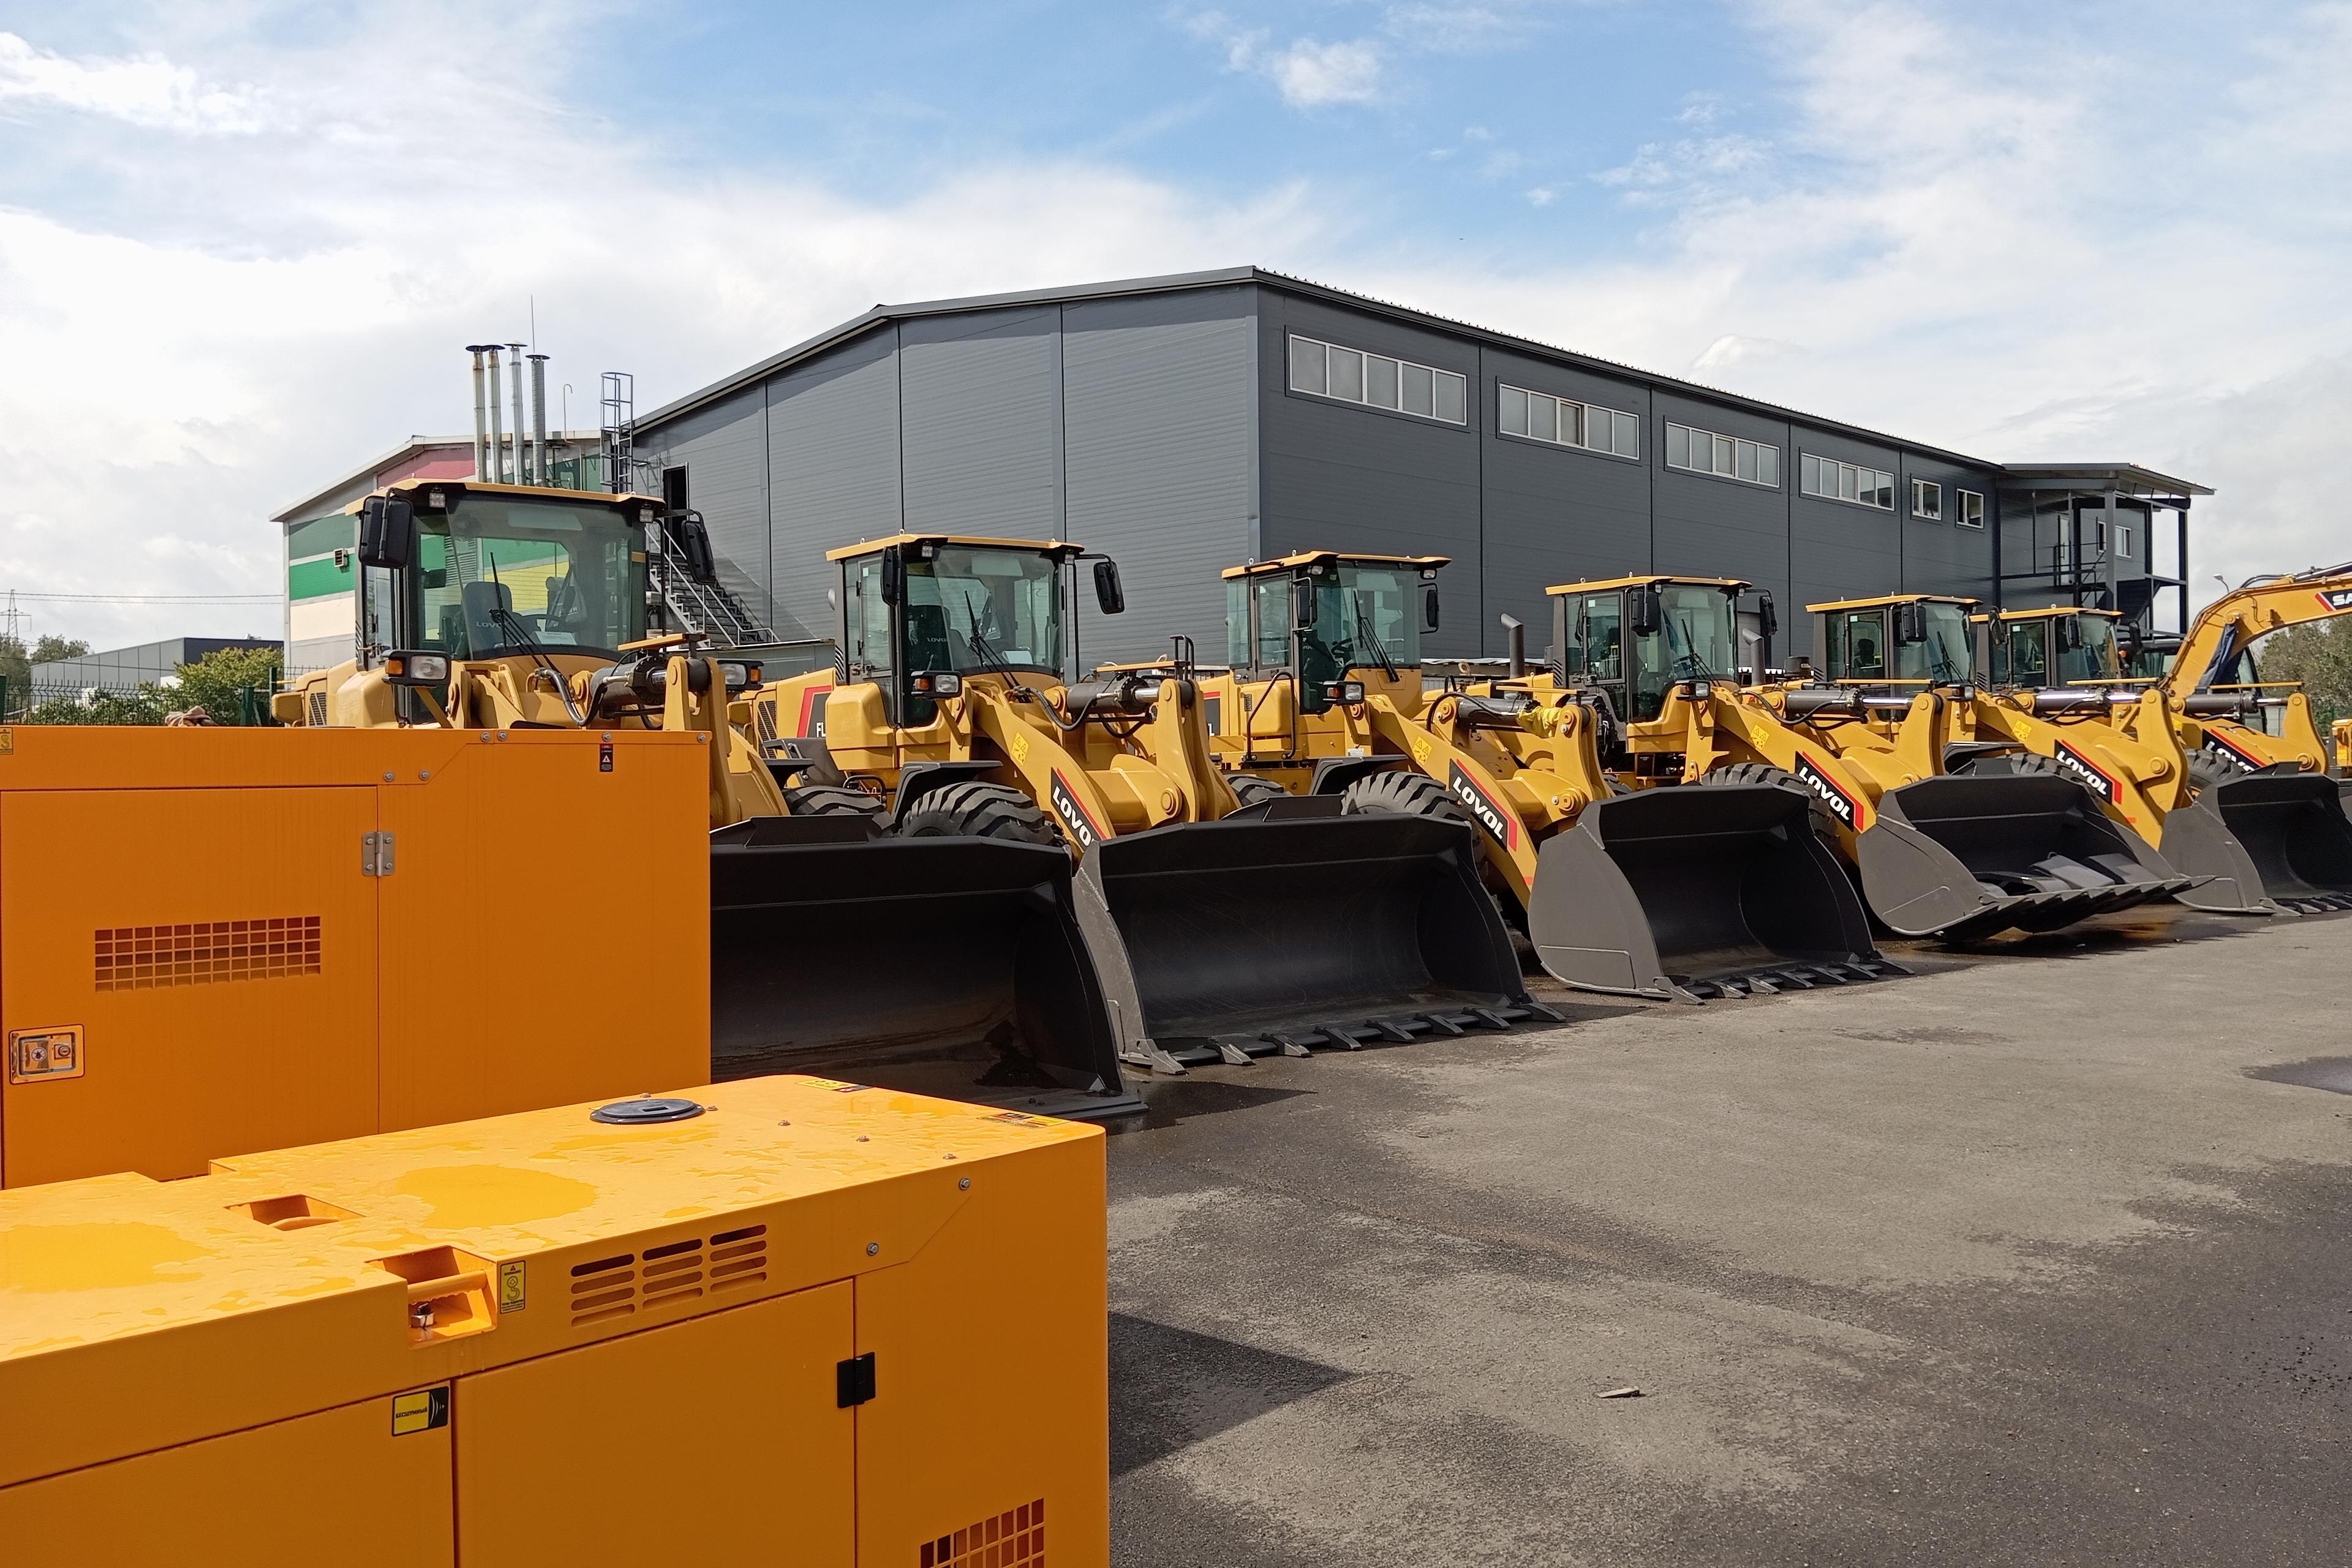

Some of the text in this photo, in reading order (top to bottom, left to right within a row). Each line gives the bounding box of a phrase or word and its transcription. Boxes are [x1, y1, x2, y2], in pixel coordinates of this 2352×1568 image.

[1799, 766, 1850, 820] LOVOL
[2056, 750, 2107, 795] LOVOL
[1053, 786, 1095, 846] LOVO
[1453, 776, 1503, 839] LOVOL
